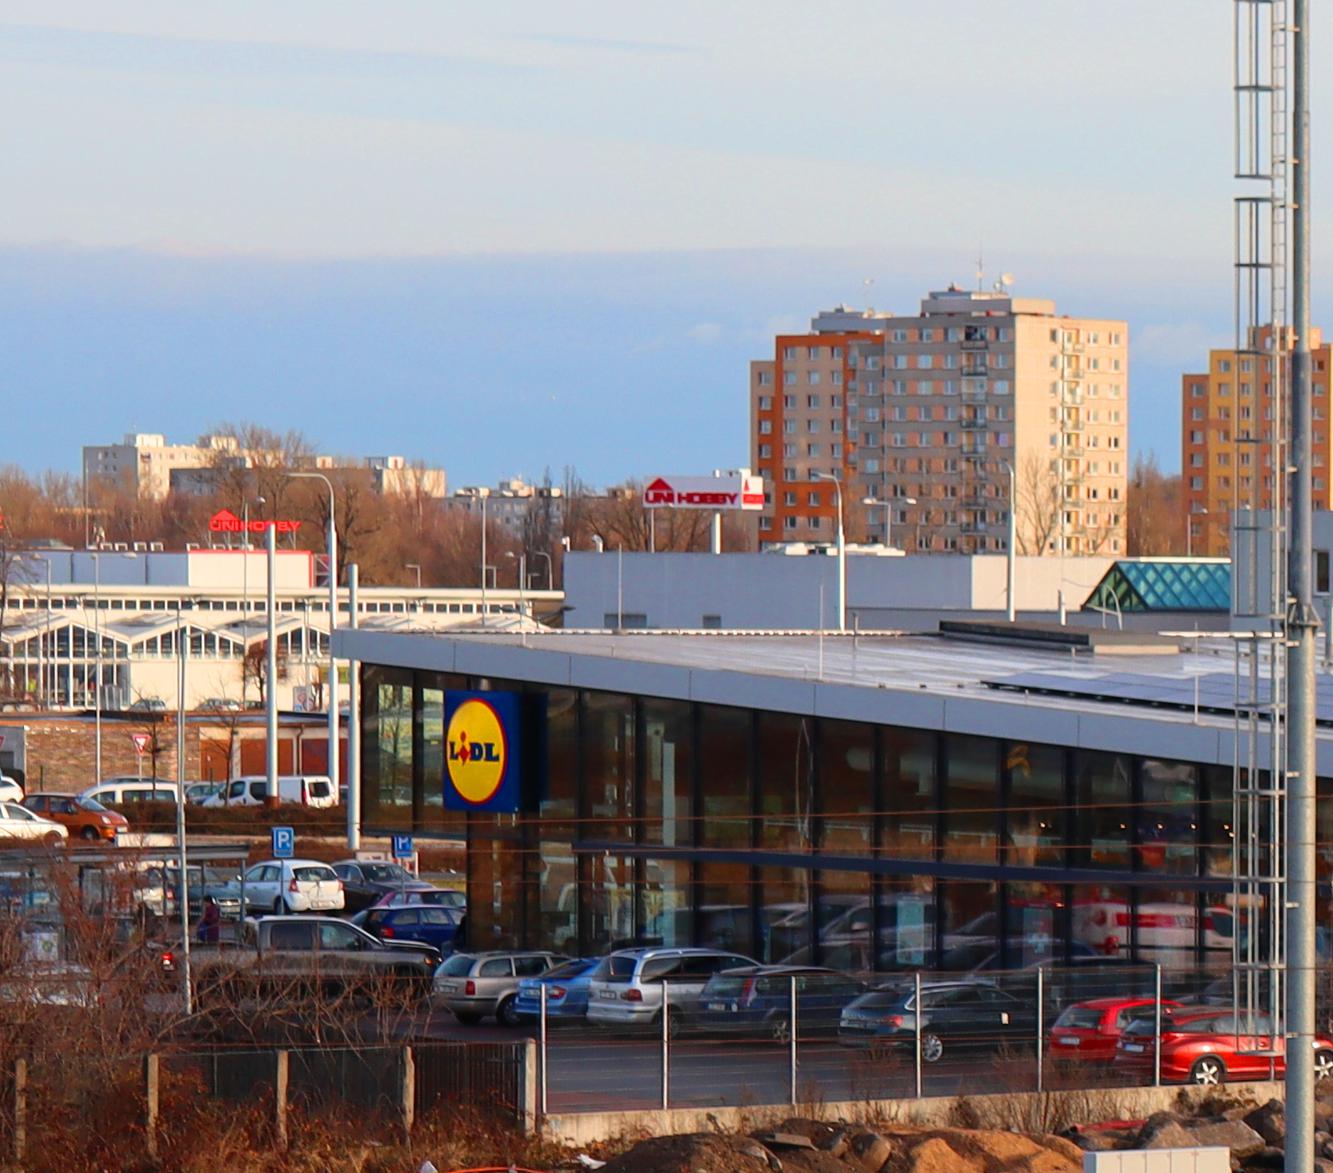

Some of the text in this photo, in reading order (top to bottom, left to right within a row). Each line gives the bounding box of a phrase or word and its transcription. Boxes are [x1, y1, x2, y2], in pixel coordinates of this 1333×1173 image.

[645, 490, 674, 504] UNI
[678, 492, 738, 505] HOBBY
[244, 520, 302, 532] HOBY
